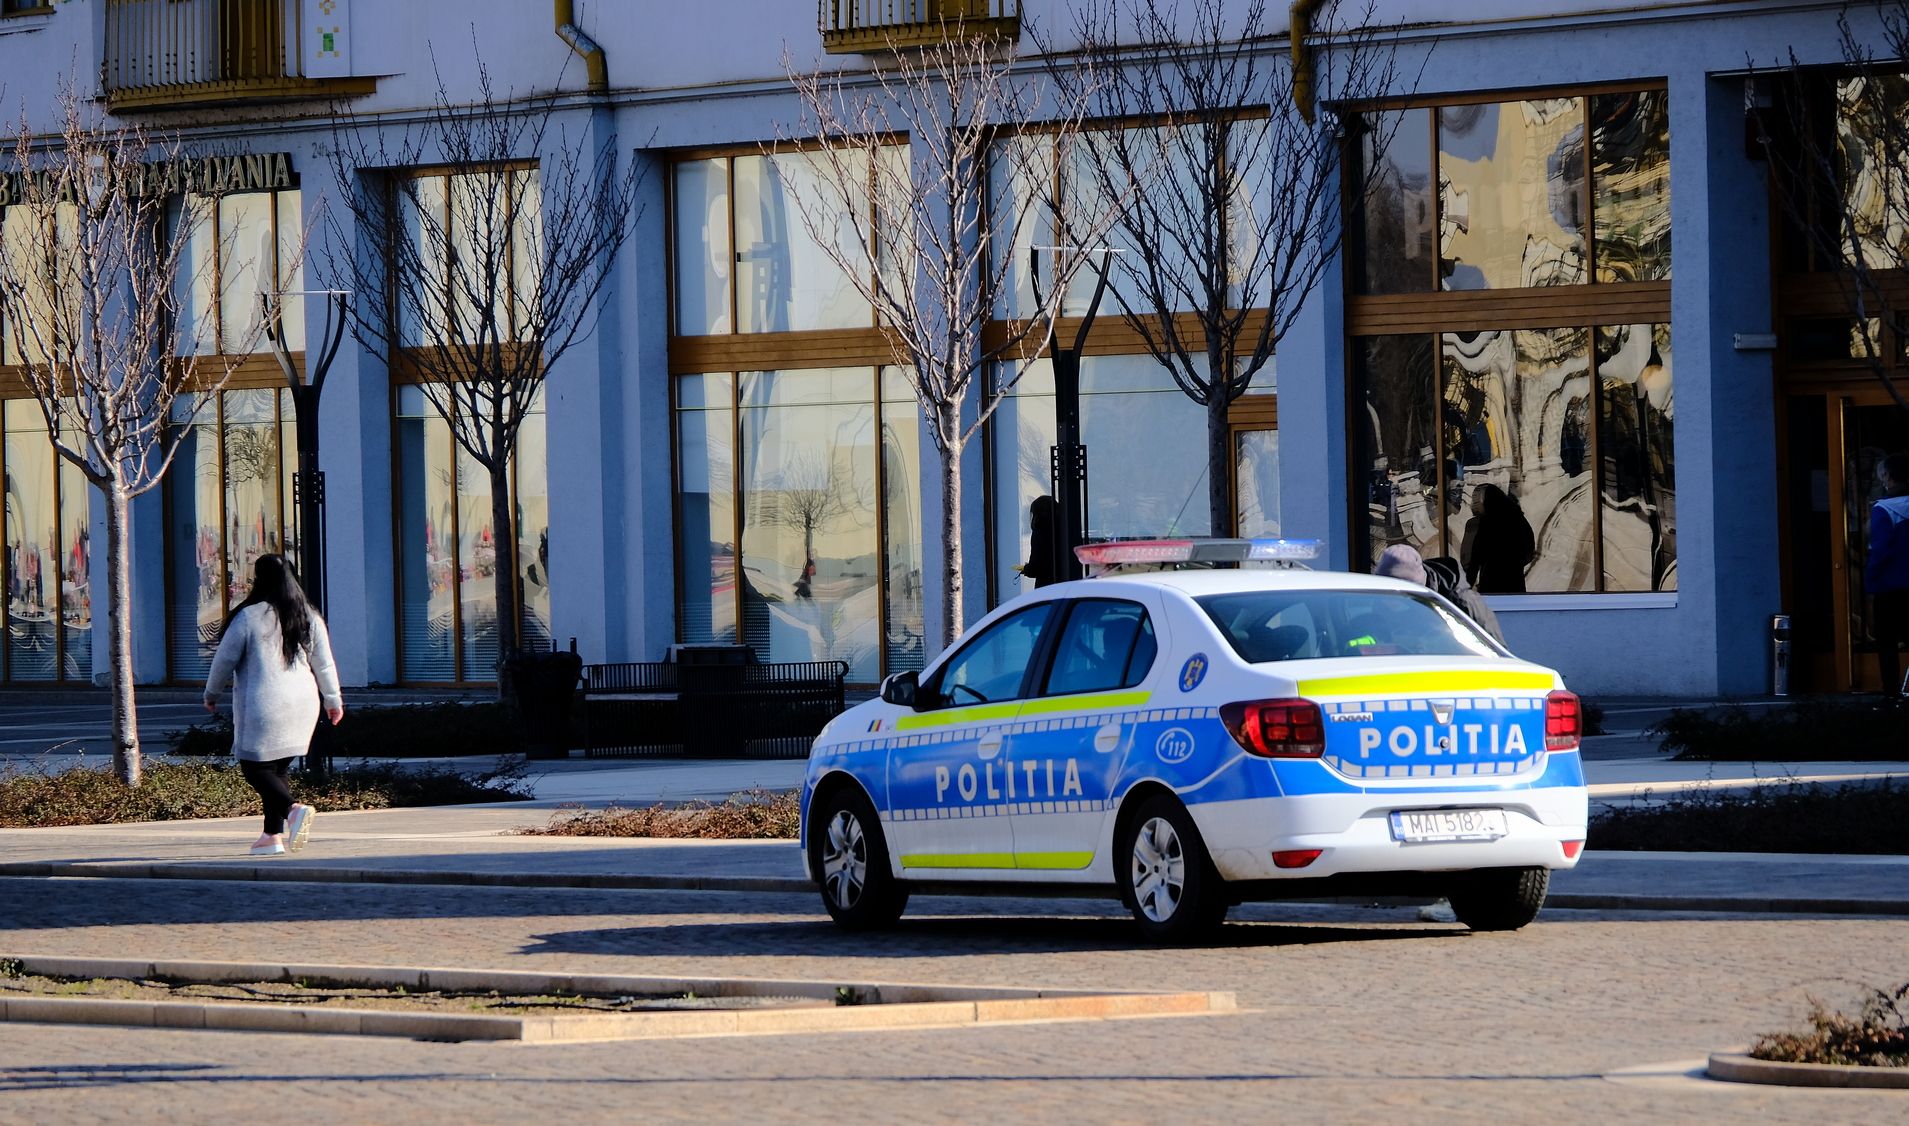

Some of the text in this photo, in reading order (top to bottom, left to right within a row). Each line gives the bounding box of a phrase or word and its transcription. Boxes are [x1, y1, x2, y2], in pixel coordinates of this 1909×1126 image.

[115, 152, 292, 197] RANSILVANIA
[1331, 714, 1372, 723] LOGAN
[1168, 740, 1187, 757] 112
[1359, 723, 1527, 759] POLITIA
[935, 758, 1084, 802] POLITIA
[1408, 813, 1440, 834] MAI
